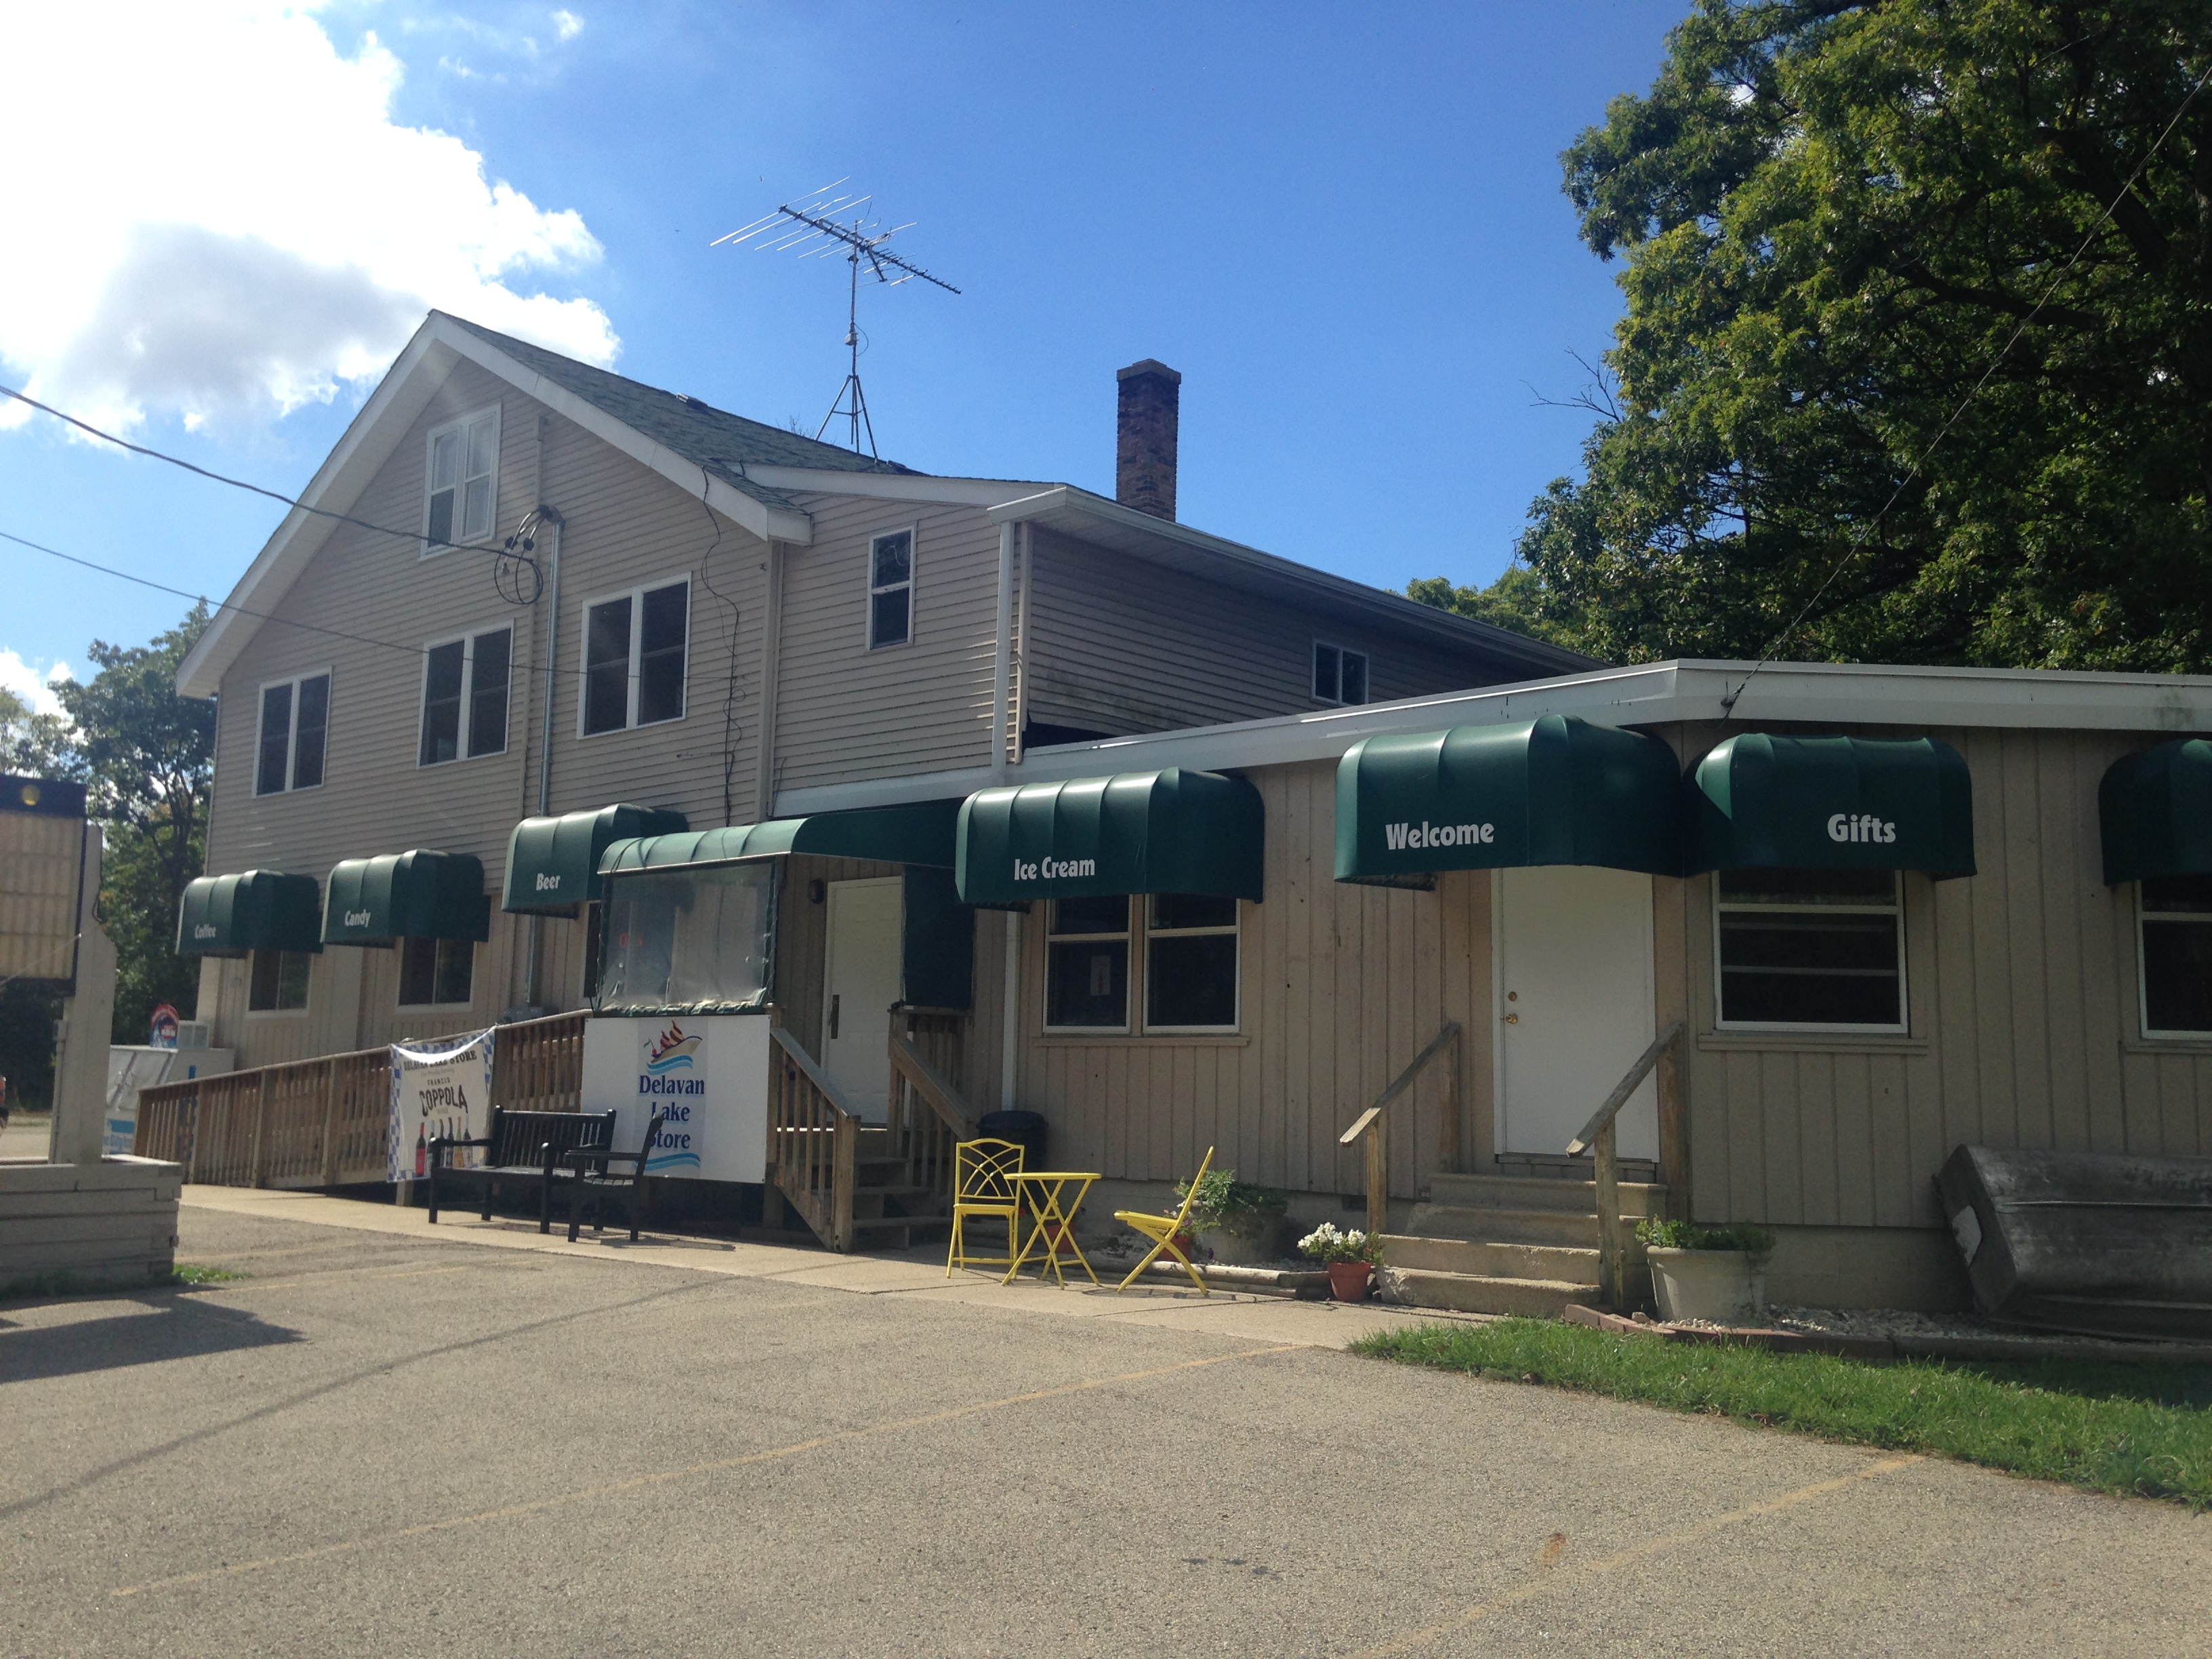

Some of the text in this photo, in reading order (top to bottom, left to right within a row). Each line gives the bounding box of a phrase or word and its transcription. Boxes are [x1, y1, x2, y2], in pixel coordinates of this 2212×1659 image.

[1385, 821, 1494, 851] Welcome
[1827, 813, 1896, 843] Gifts
[1014, 856, 1095, 880] Ice Cream
[535, 873, 561, 891] Beer
[344, 909, 371, 928] Candy
[194, 924, 216, 940] Coffee
[639, 1075, 705, 1094] Delavan
[419, 1084, 468, 1117] COPPOLA
